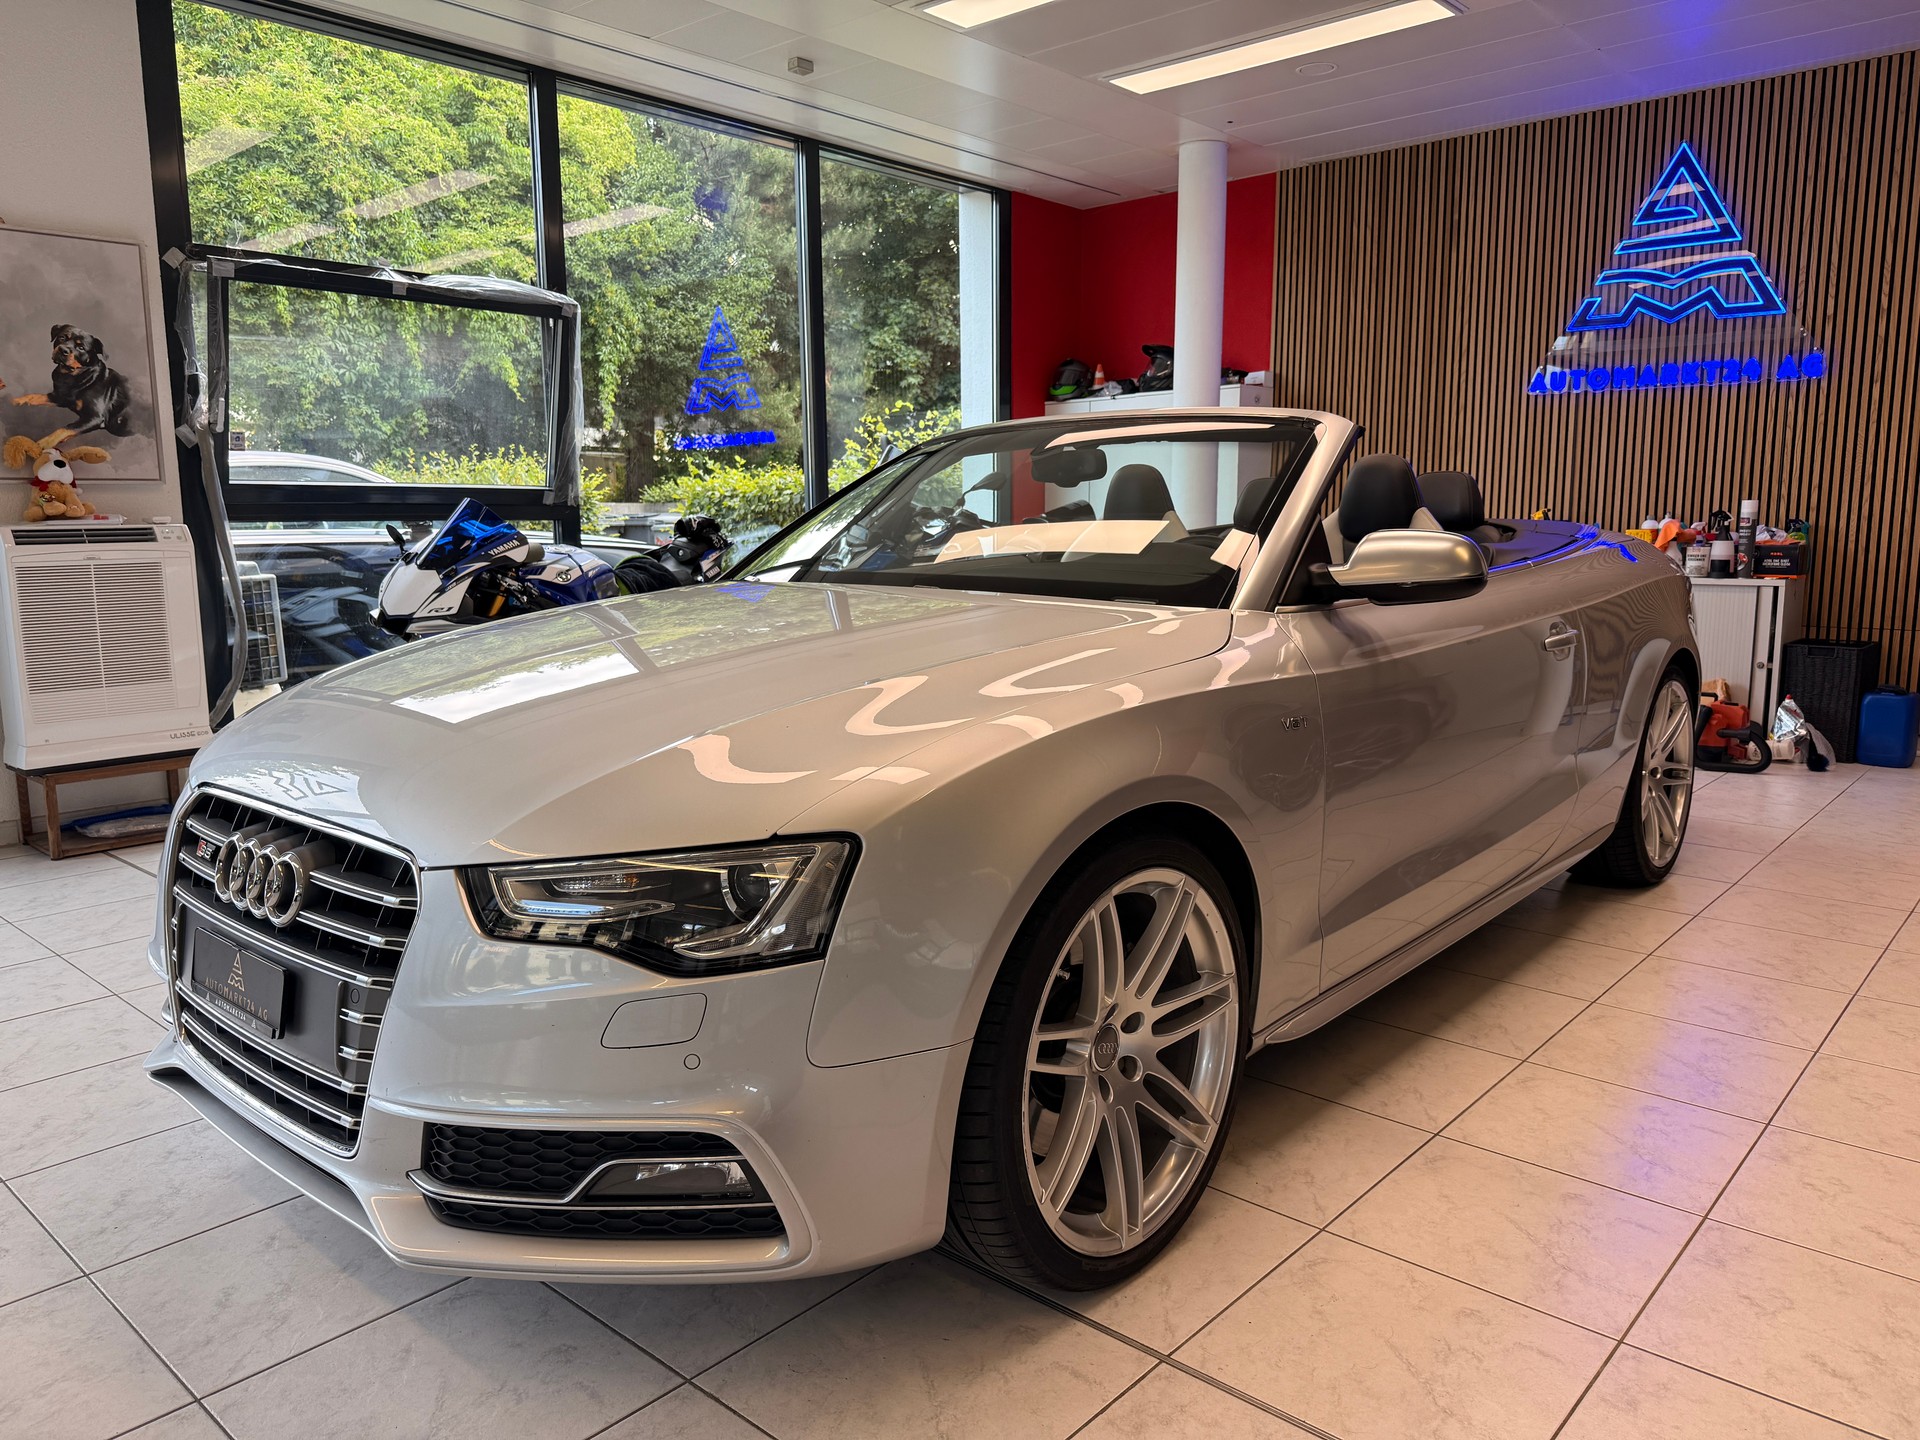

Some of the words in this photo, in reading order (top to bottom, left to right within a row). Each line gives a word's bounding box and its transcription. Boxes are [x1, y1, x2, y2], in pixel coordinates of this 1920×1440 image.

[1528, 356, 1763, 393] AUTOMARKT24
[1775, 352, 1824, 380] AG
[487, 539, 520, 556] YAMAHA
[169, 730, 196, 740] ULISSE
[204, 977, 256, 1014] AUTOMARKT24
[257, 1006, 269, 1021] AG
[215, 998, 247, 1021] AUTOMARKT24
